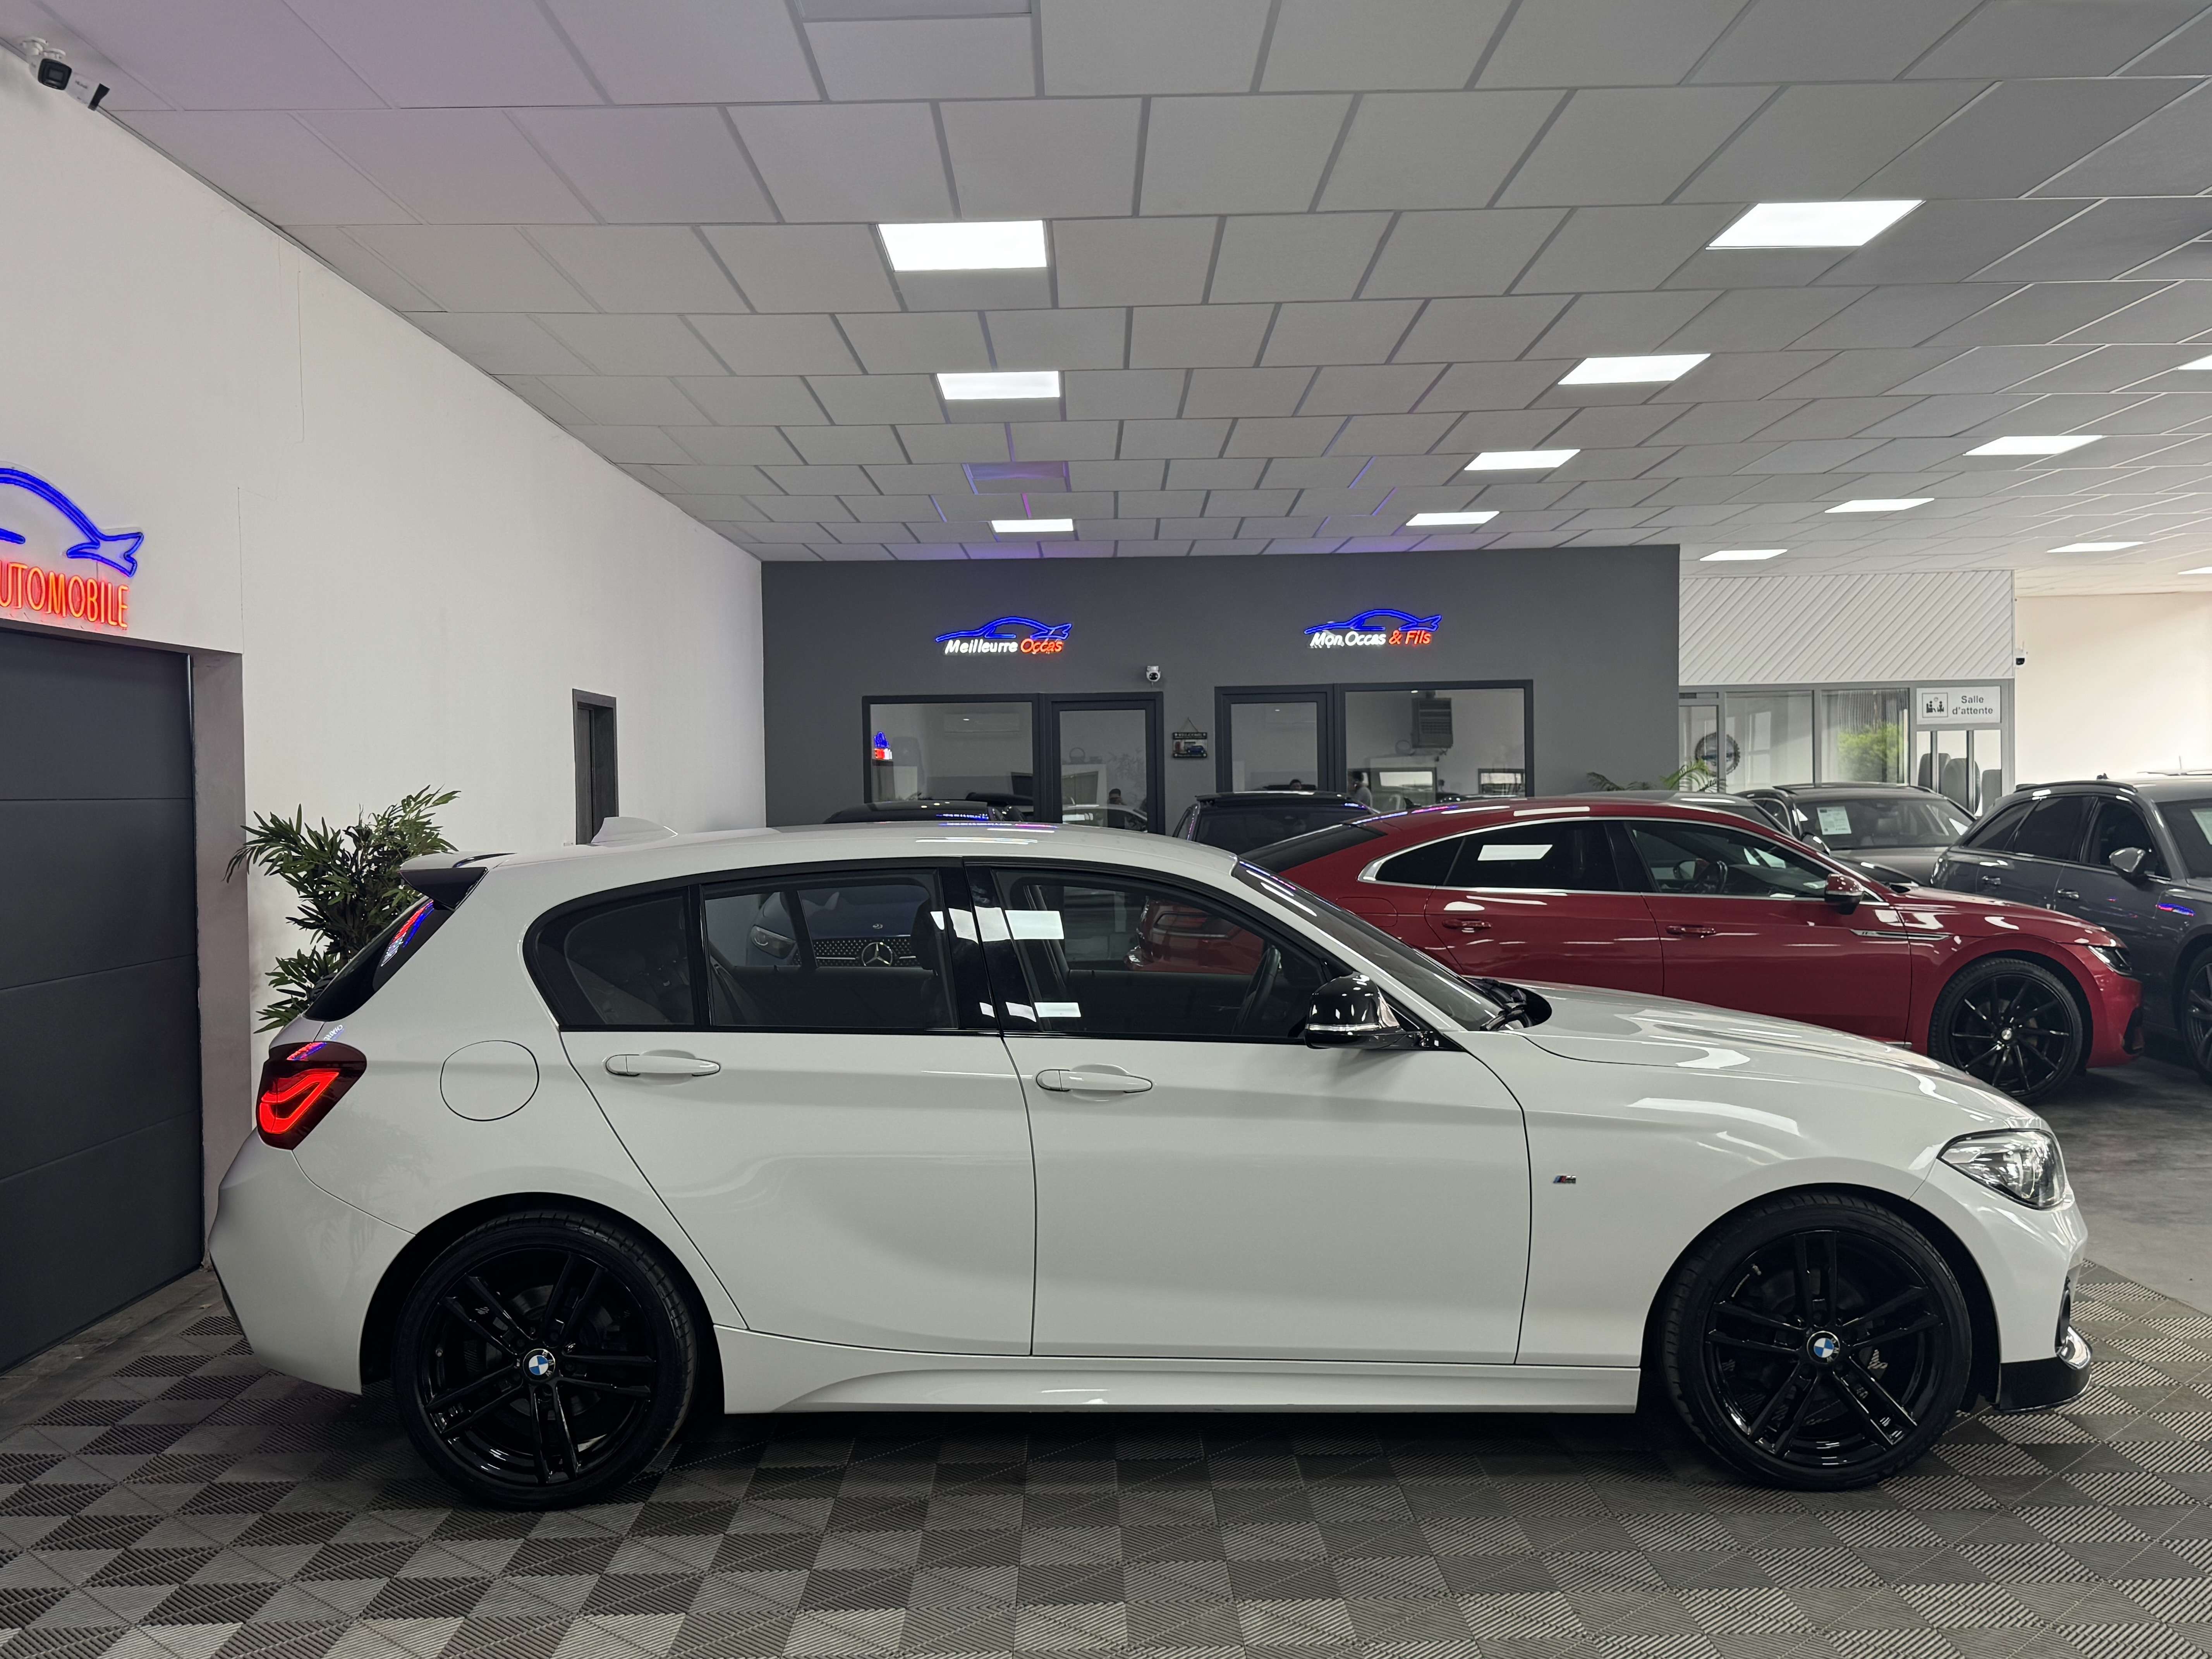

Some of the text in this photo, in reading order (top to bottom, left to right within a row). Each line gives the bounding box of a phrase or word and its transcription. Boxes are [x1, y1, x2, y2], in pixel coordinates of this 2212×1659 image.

[945, 638, 1064, 654] Meilleurre Occas
[1310, 630, 1432, 647] Mon Occas & Fils
[1961, 696, 1984, 704] Salle
